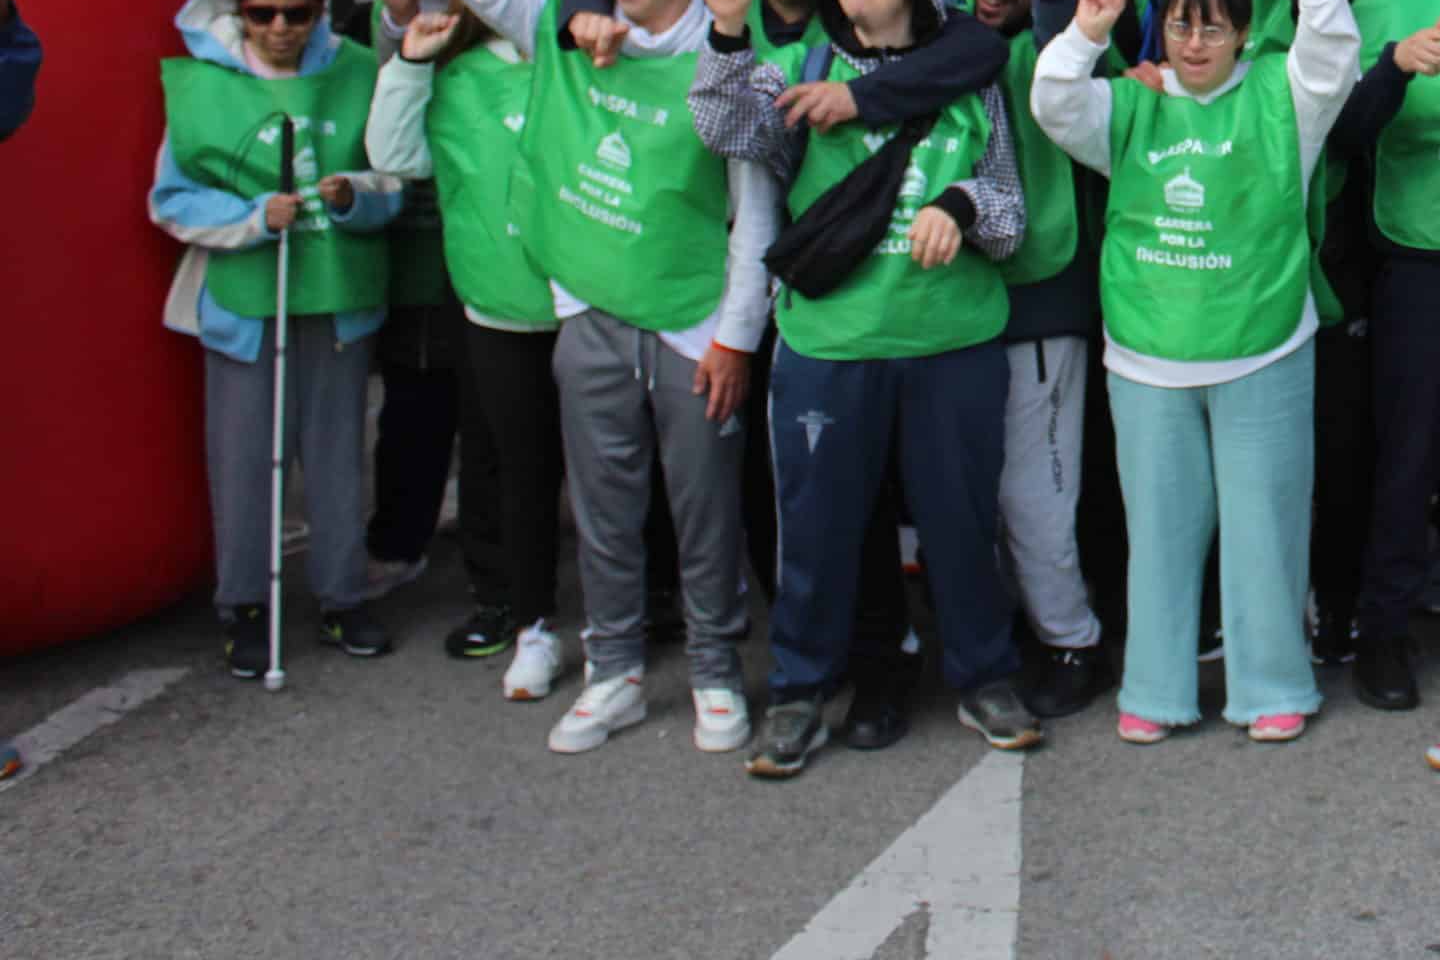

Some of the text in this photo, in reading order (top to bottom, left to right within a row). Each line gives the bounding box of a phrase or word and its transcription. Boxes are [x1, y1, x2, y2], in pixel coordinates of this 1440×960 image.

[1159, 232, 1206, 249] POR LA
[1136, 246, 1233, 270] INCLUSIÓN
